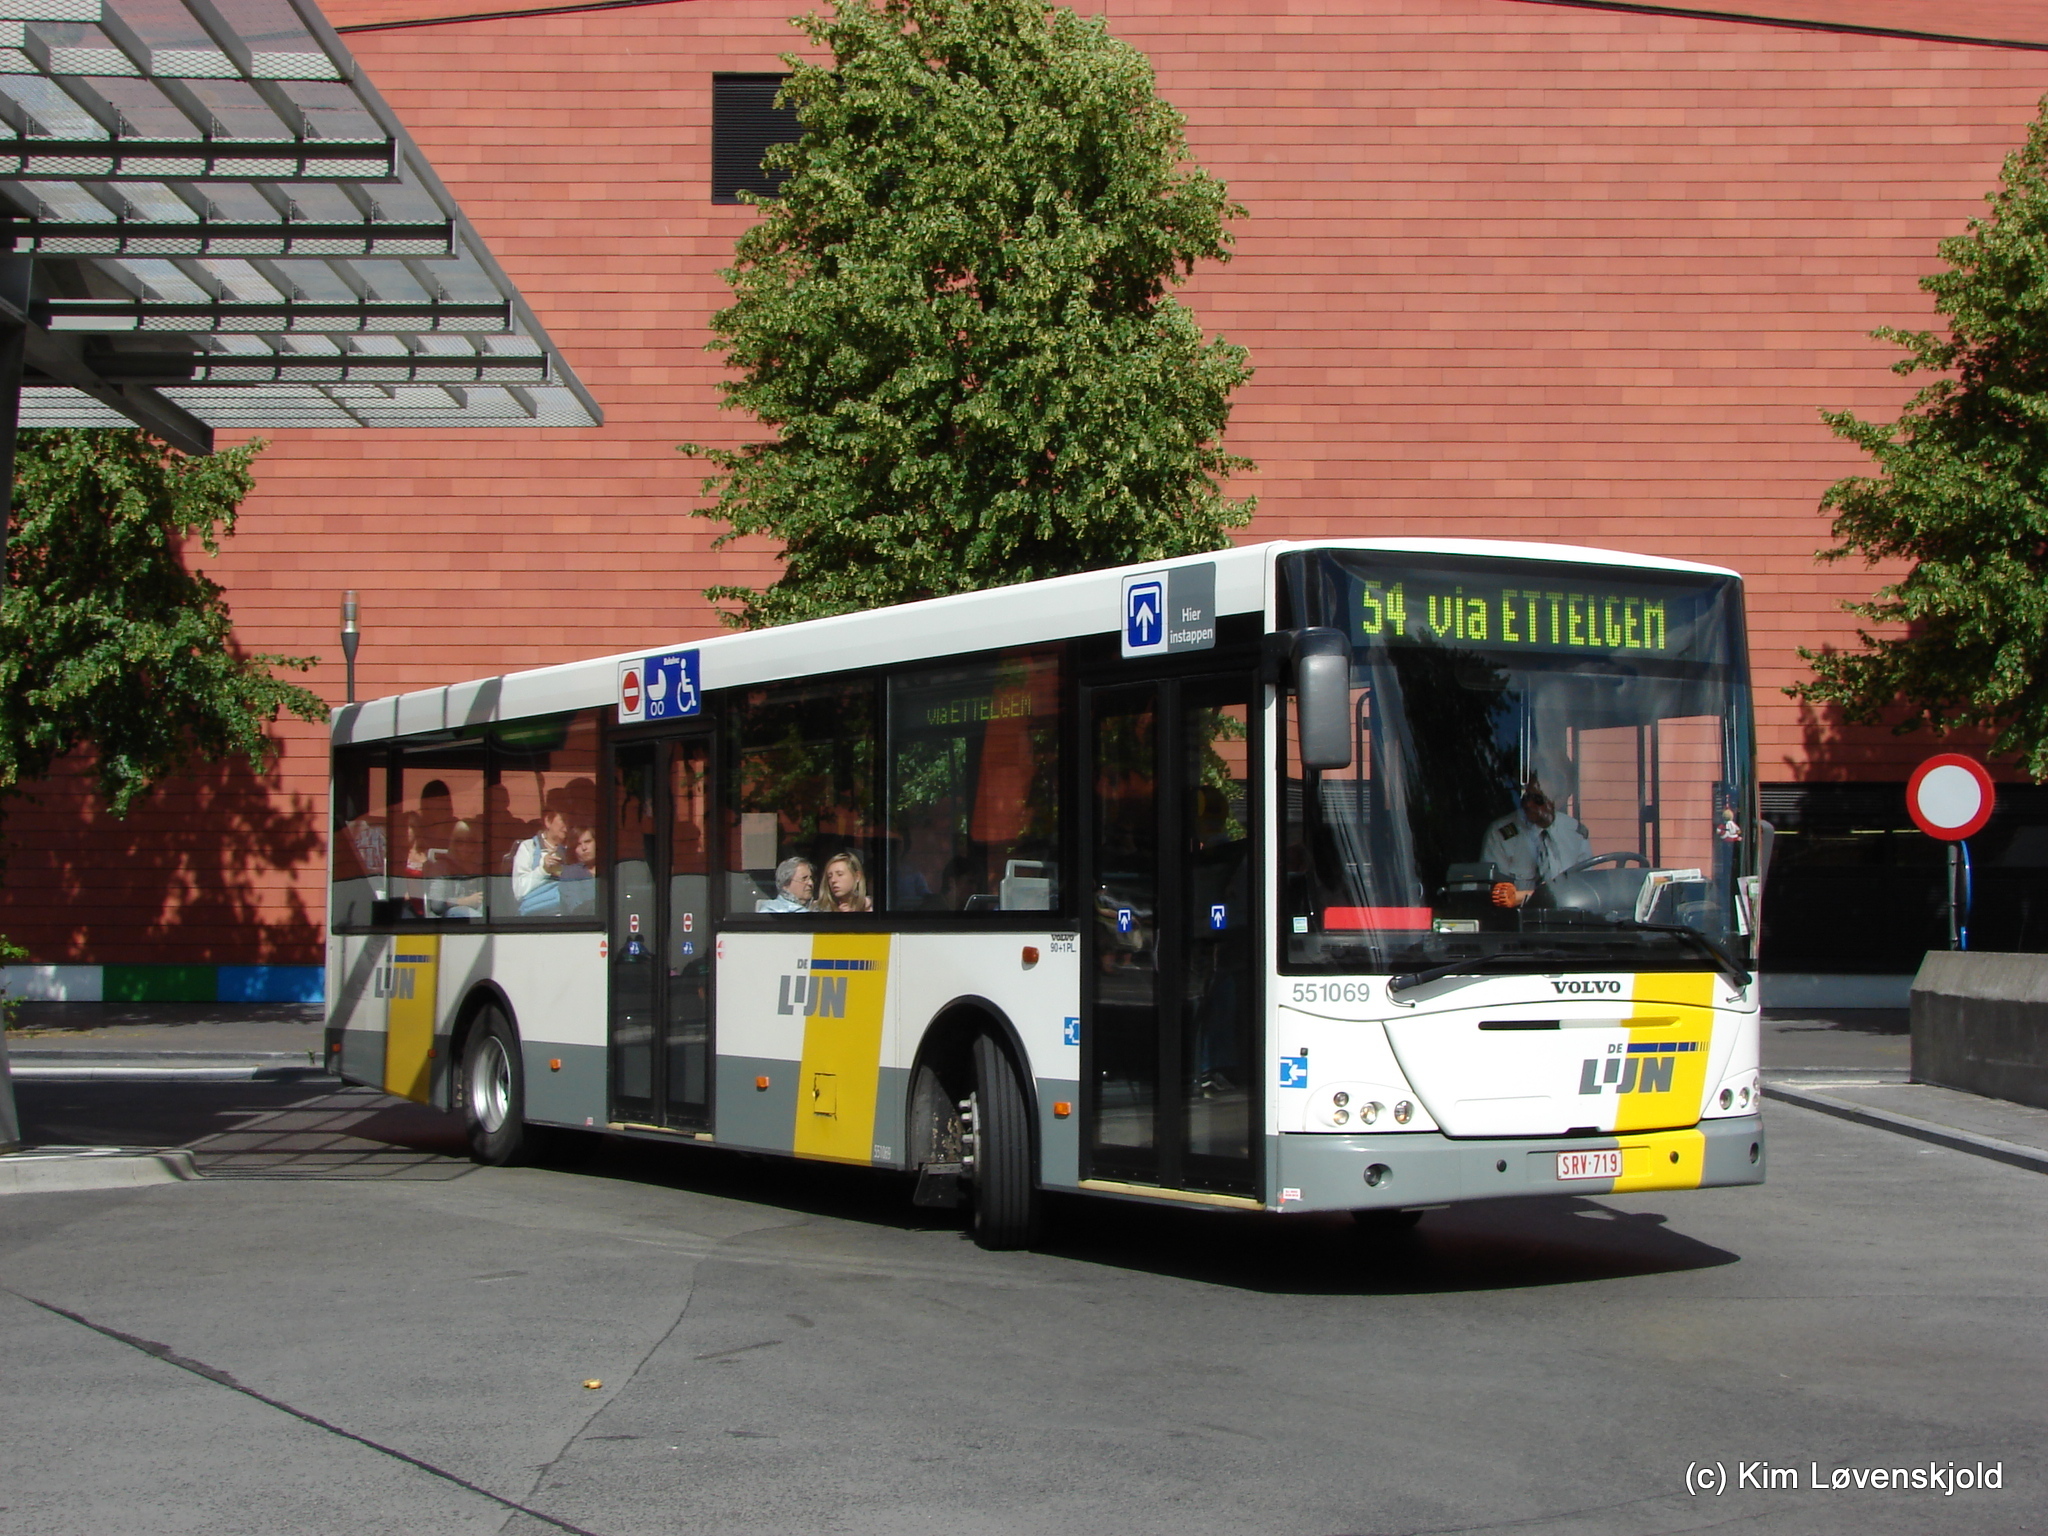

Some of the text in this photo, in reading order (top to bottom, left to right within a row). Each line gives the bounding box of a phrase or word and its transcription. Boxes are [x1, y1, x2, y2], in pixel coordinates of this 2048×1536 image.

[1181, 607, 1202, 622] Hier
[1363, 580, 1666, 650] 54 via ETTELGEM
[1169, 628, 1213, 644] instappen
[797, 958, 808, 969] DE
[1292, 983, 1371, 1003] 551069
[1551, 981, 1622, 994] VOLVO
[777, 975, 848, 1018] LIJN
[1607, 1043, 1623, 1054] DE
[1578, 1056, 1676, 1095] LIJN
